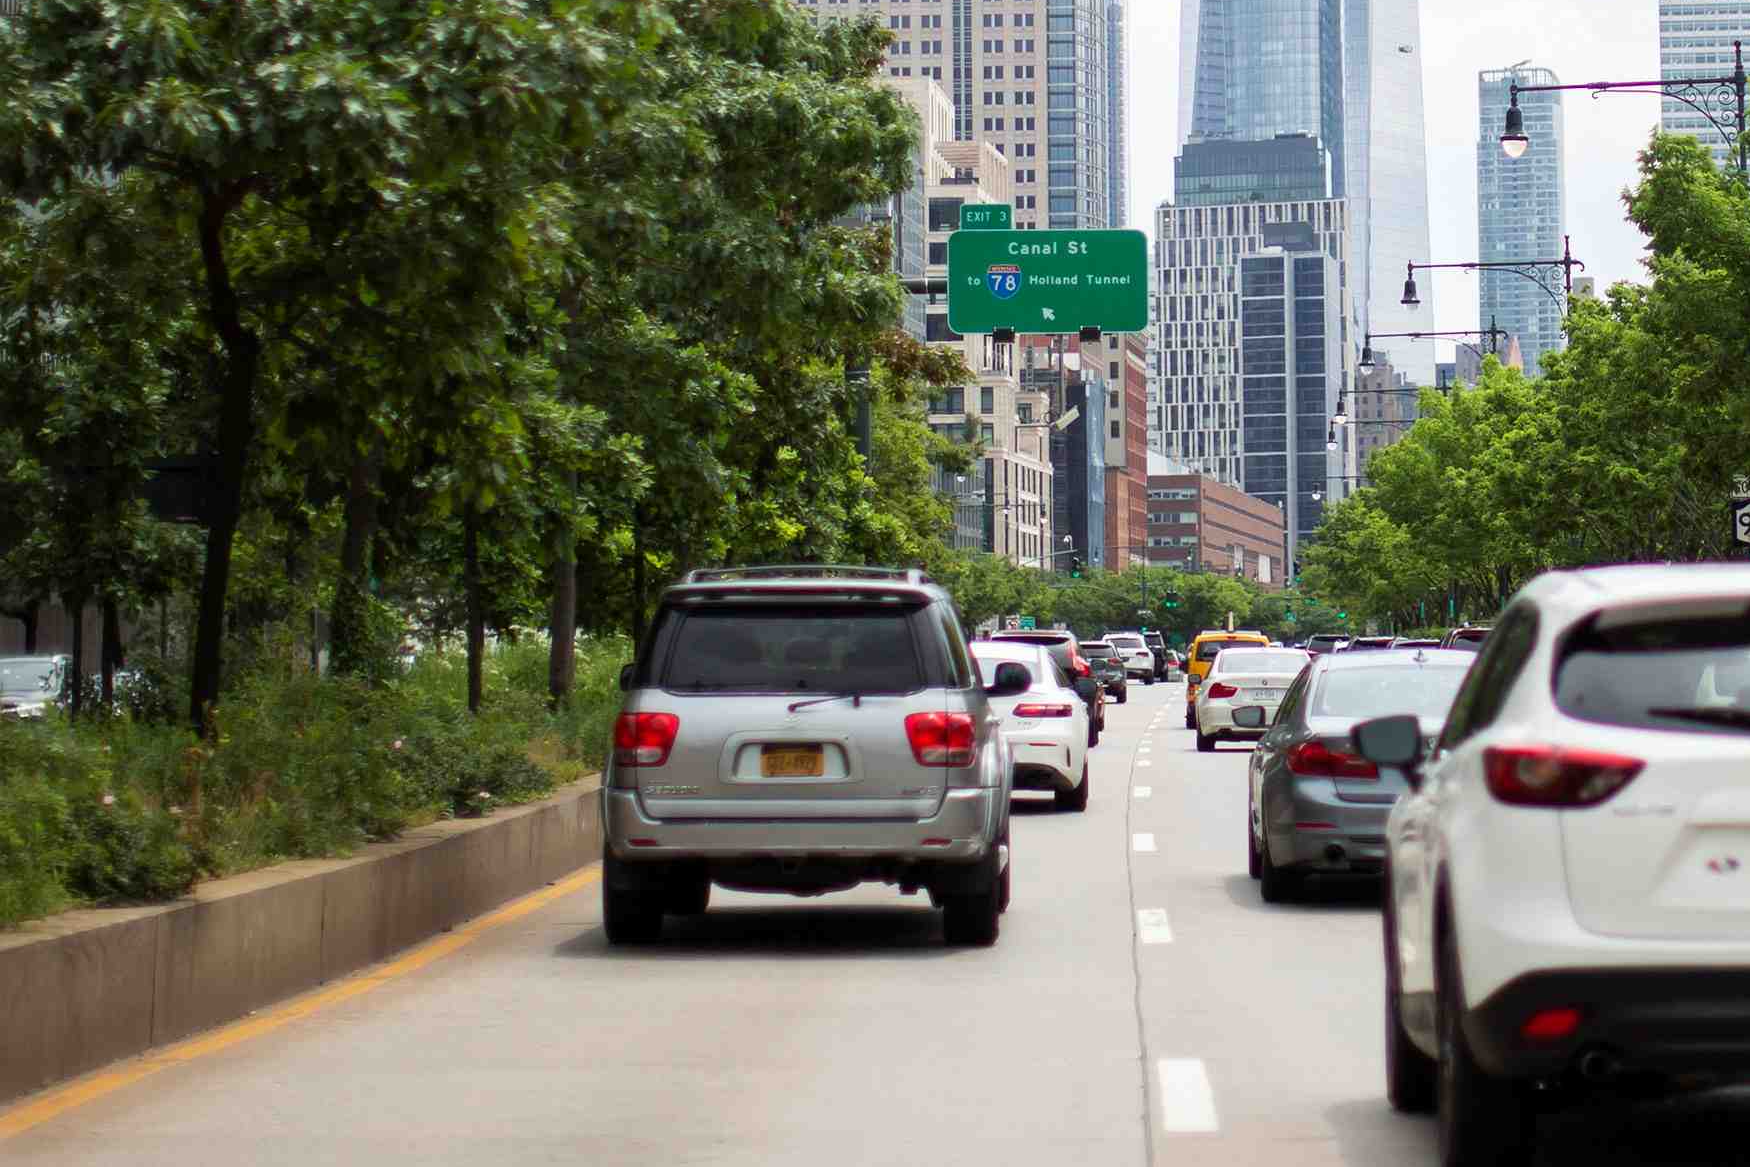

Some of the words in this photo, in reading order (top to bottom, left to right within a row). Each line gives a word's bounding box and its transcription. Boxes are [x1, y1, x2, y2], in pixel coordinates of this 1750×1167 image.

[967, 211, 992, 222] EXIT
[999, 211, 1008, 222] 3
[1008, 241, 1057, 255] Canal
[1067, 241, 1088, 255] St
[967, 275, 981, 286] to
[991, 275, 1017, 291] 78
[1029, 274, 1078, 285] Holland
[1086, 274, 1131, 285] Tunnel
